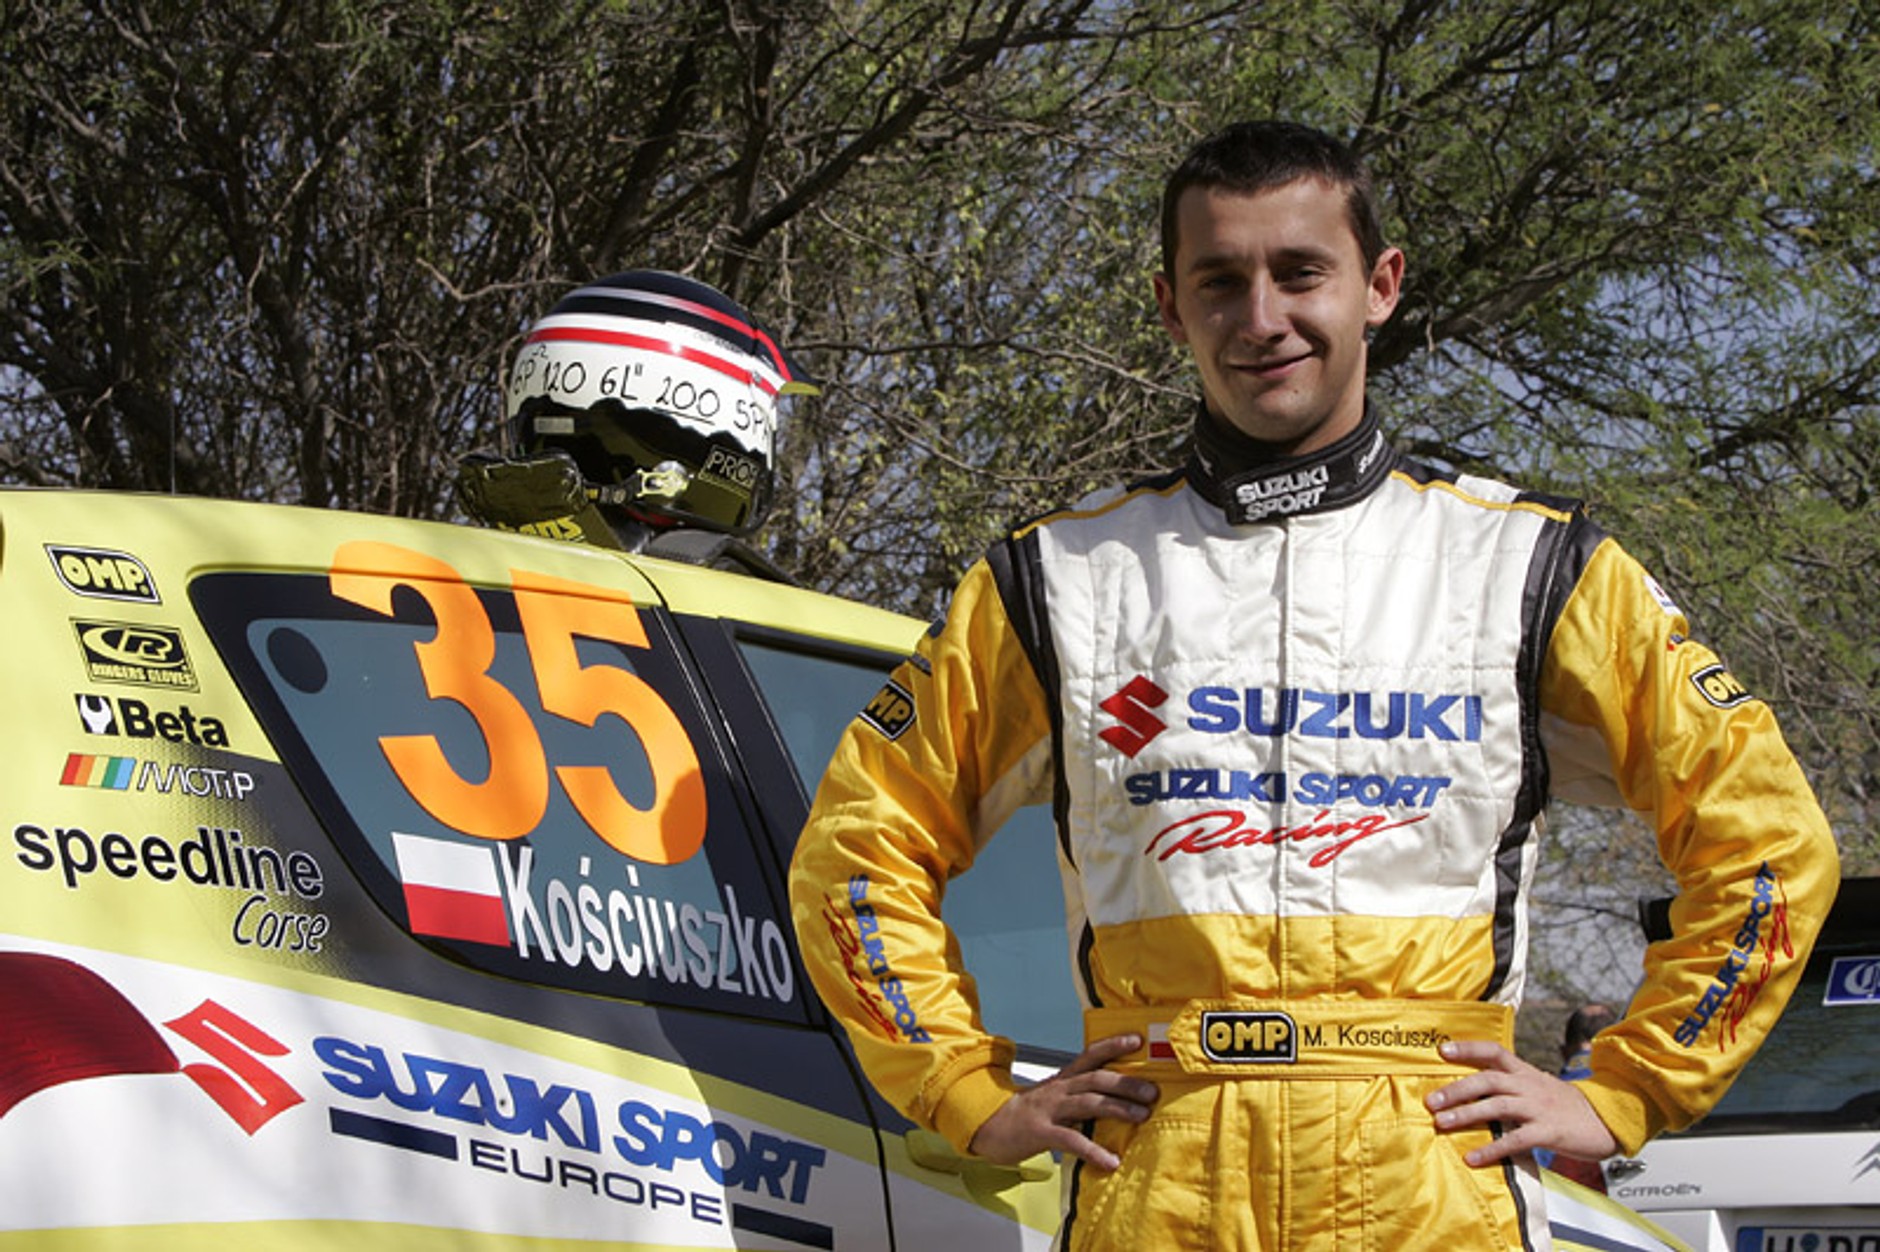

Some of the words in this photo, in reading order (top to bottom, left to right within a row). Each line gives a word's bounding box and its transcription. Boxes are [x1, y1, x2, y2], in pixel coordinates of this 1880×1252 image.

[656, 375, 721, 418] 200
[1236, 464, 1330, 503] SUZUKI
[1244, 485, 1328, 522] SPORT
[117, 698, 229, 748] Beta
[328, 540, 708, 866] 35
[1186, 685, 1483, 743] SUZUKI
[1125, 768, 1287, 807] SUZUKI
[1293, 771, 1452, 808] SPORT
[14, 823, 325, 897] speedline
[1144, 809, 1431, 869] Racing
[232, 895, 329, 953] Corse
[496, 840, 794, 1004] Kościuszko
[1674, 947, 1751, 1049] SUZUKI
[1734, 860, 1778, 957] SPORT
[1303, 1024, 1328, 1047] M.
[310, 1035, 602, 1154] SUZUKI
[613, 1100, 827, 1205] SPORT
[470, 1140, 724, 1225] EUROPE
